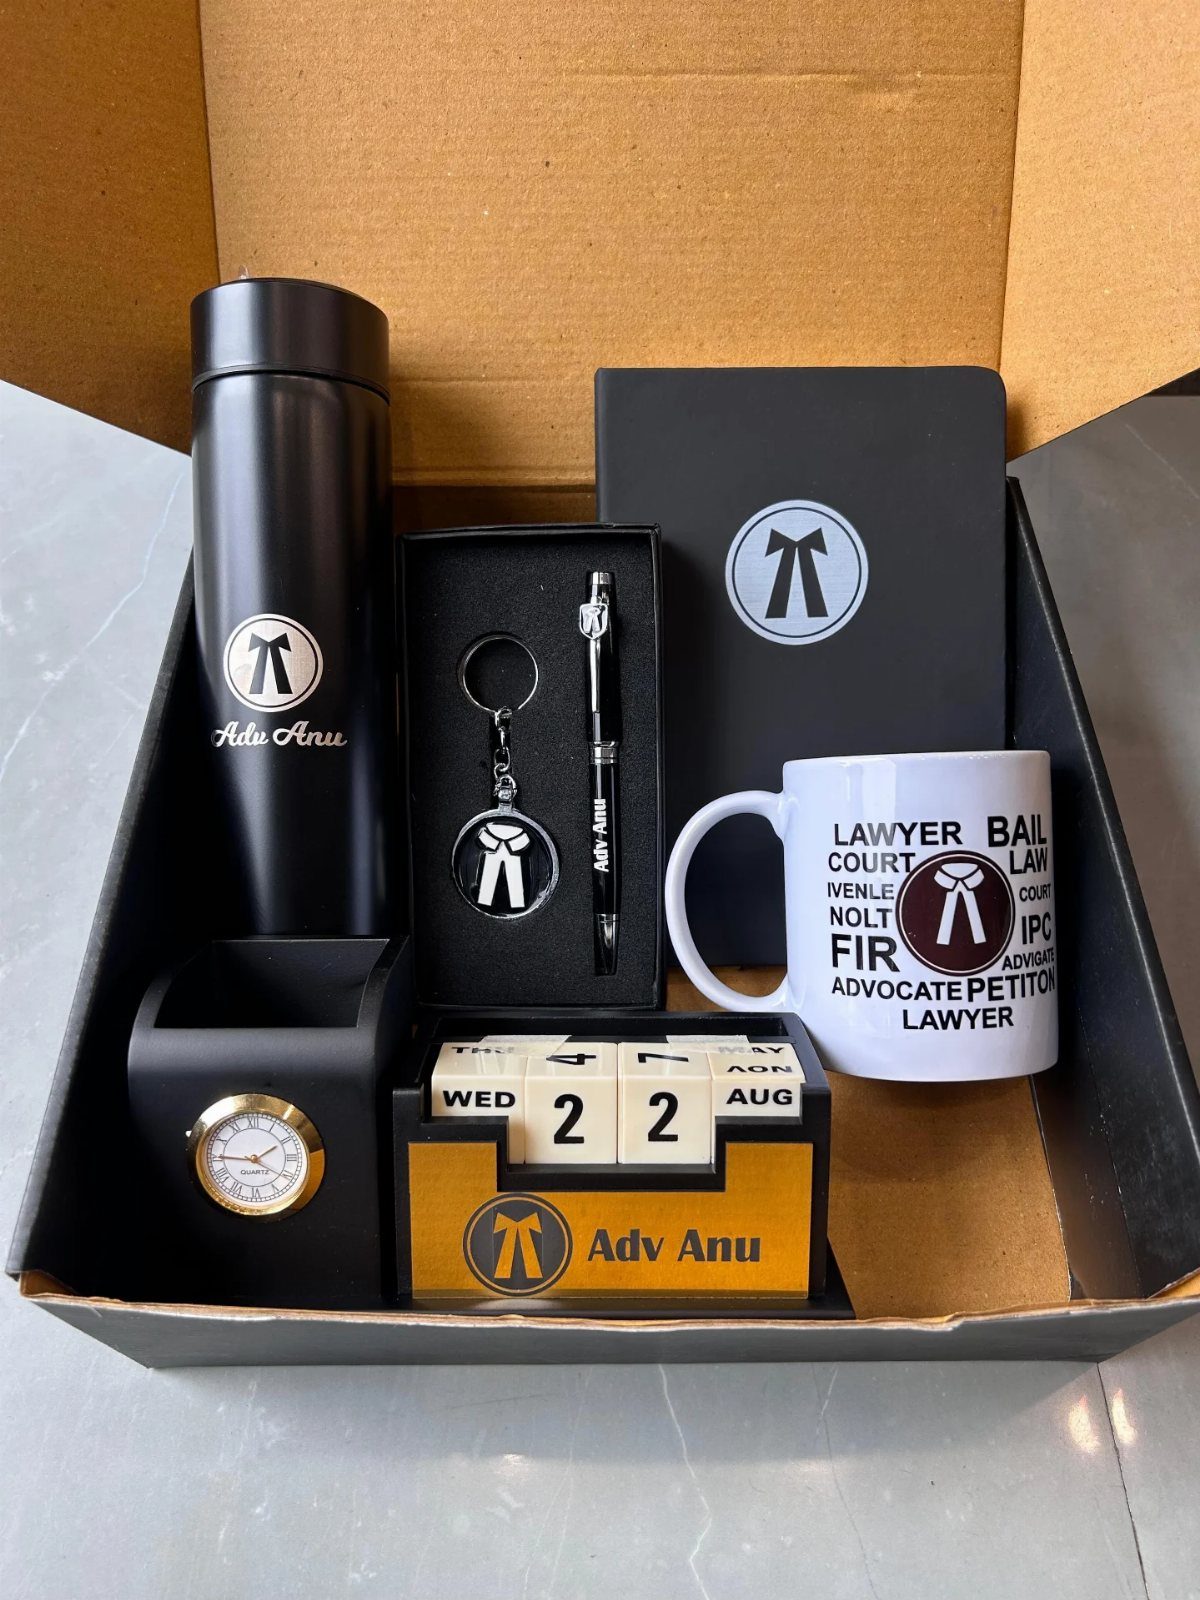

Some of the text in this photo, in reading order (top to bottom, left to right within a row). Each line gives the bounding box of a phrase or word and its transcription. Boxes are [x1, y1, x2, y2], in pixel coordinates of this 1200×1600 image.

[211, 721, 347, 747] Adv Anu
[592, 799, 609, 872] Adv Anu
[834, 821, 963, 846] LAWYER
[987, 814, 1047, 847] BAIL
[828, 852, 916, 873] COURT
[1009, 847, 1048, 875] LAW
[827, 882, 894, 900] IVENLE
[1019, 883, 1051, 902] COURT
[830, 906, 893, 928] NOLT
[1021, 912, 1052, 945] IPC
[831, 933, 900, 972] FIR
[1001, 947, 1054, 971] ADVIGATE
[831, 965, 1055, 1002] ADVOCATE PETITON
[902, 1006, 1014, 1030] LAWYER
[442, 1090, 516, 1108] WED
[726, 1088, 793, 1105] AUG
[553, 1093, 585, 1144] 2
[647, 1091, 679, 1142] 2
[587, 1228, 761, 1262] Adv Anu
